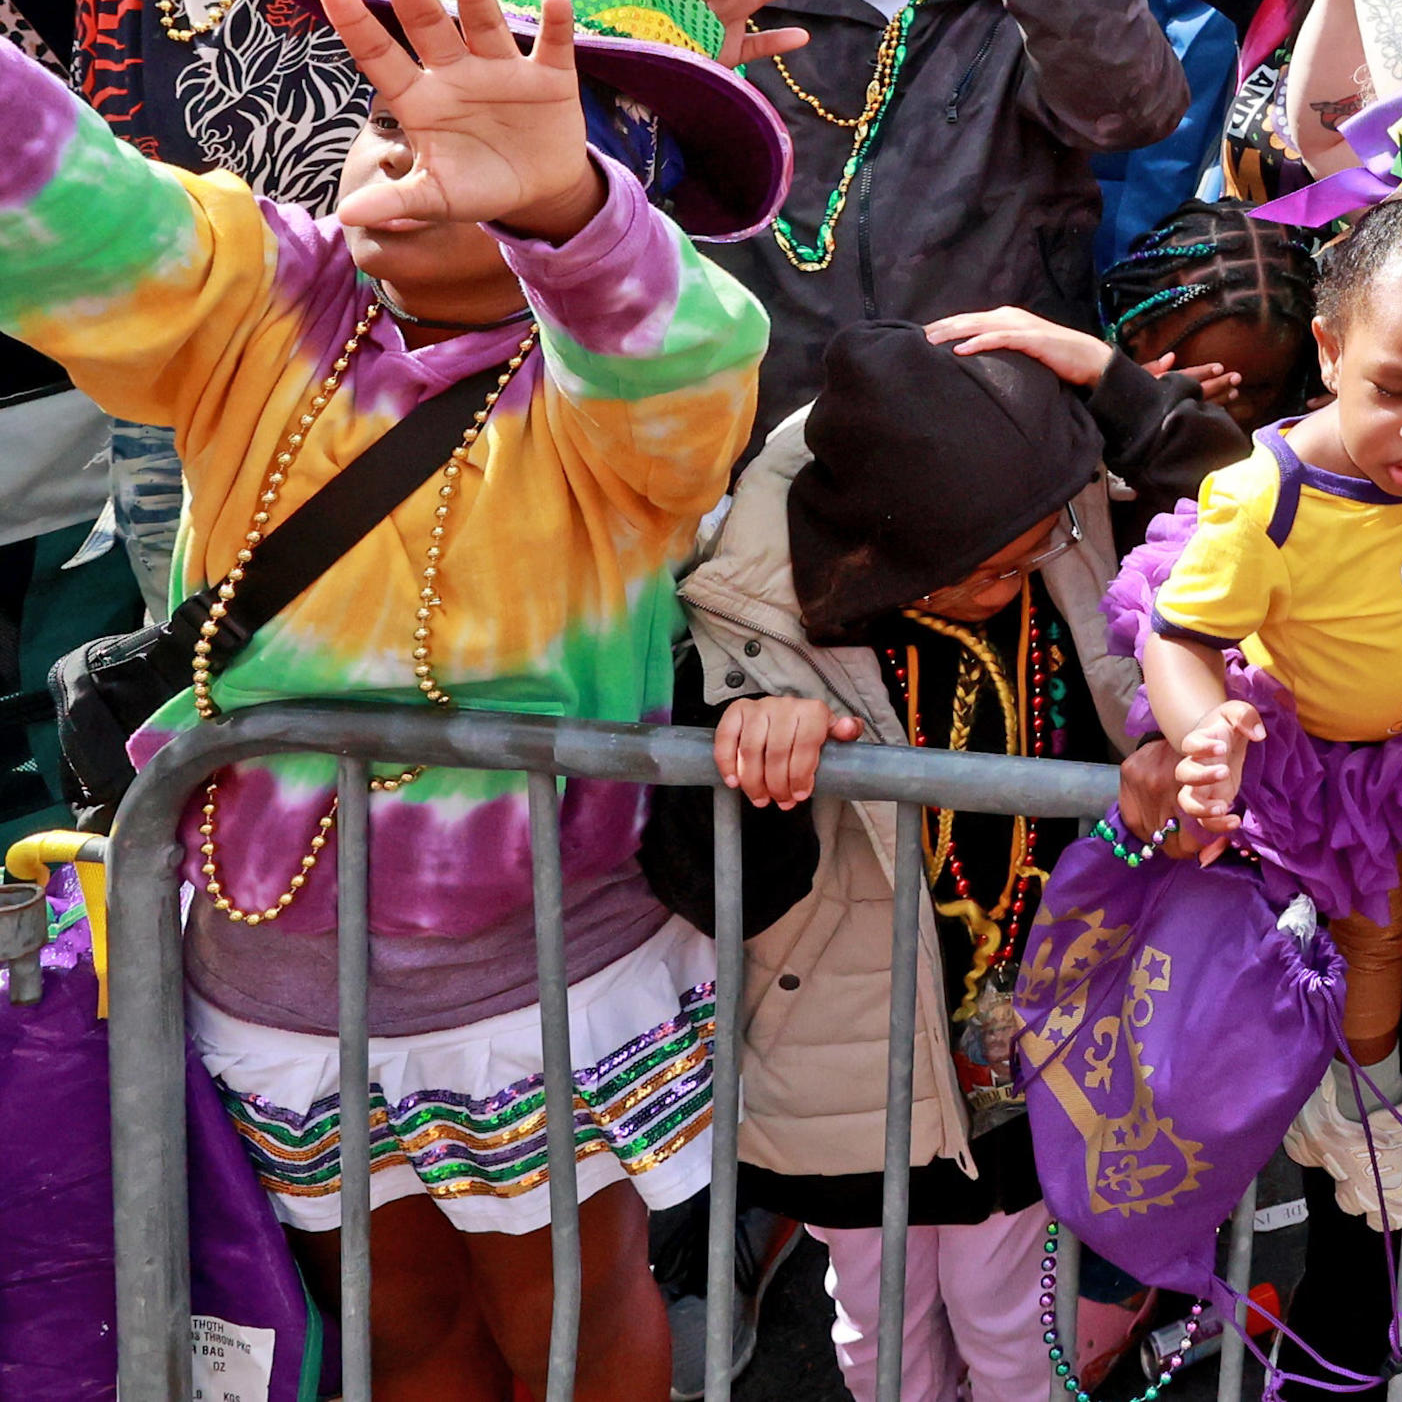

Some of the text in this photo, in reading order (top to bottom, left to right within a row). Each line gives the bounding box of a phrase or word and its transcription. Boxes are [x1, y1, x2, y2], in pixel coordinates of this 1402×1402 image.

[192, 1319, 225, 1334] THOTH
[204, 1331, 235, 1348] THROW
[236, 1340, 252, 1355] PKG
[202, 1345, 225, 1358] BAG
